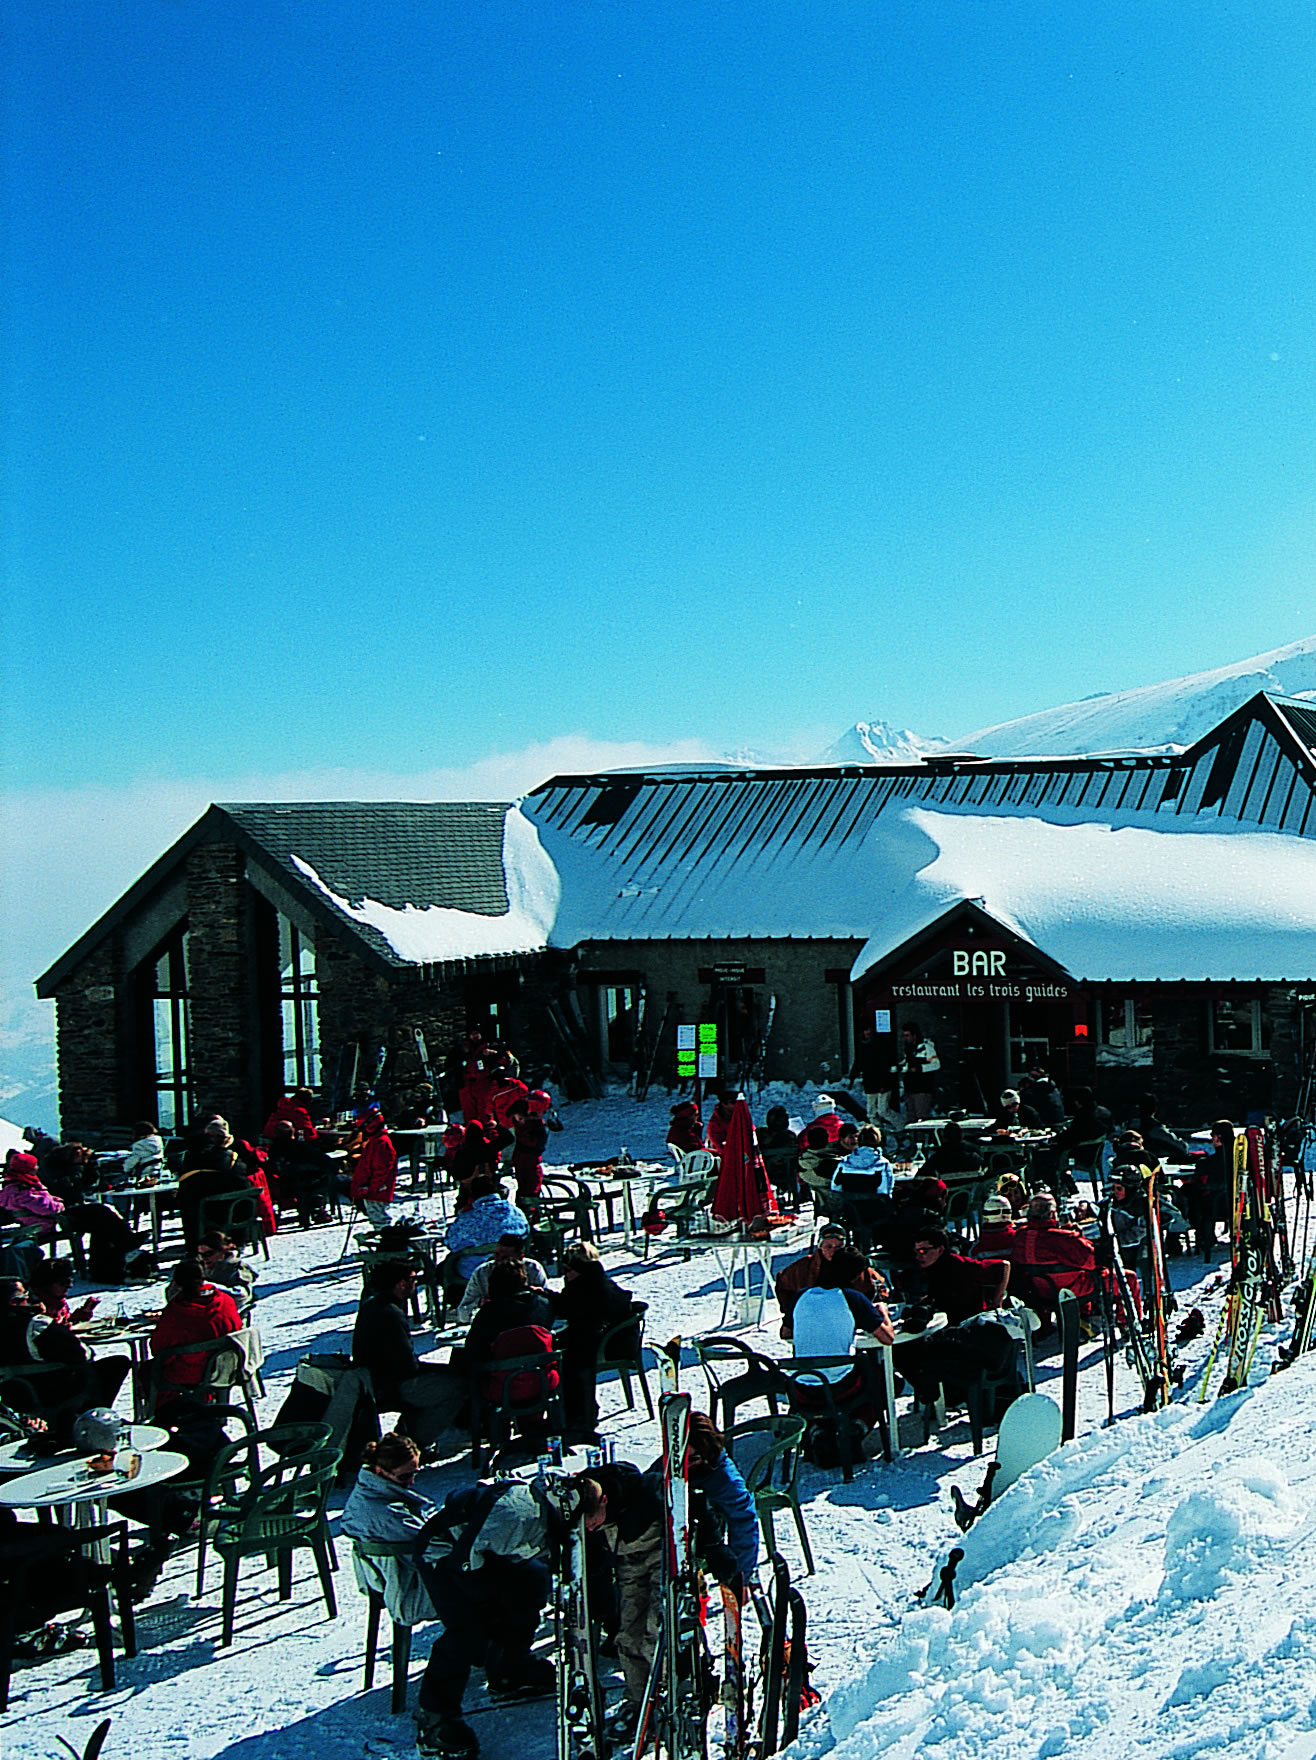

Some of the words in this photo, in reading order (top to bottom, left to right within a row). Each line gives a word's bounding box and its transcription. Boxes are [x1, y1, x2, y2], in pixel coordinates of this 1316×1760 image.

[953, 950, 1006, 976] BAR
[891, 983, 960, 997] restaurant
[967, 983, 985, 997] les
[990, 983, 1021, 997] trois
[1026, 984, 1068, 1002] guides
[1256, 1133, 1265, 1178] ATOMIC
[1236, 1249, 1259, 1357] ROSSIGNOL
